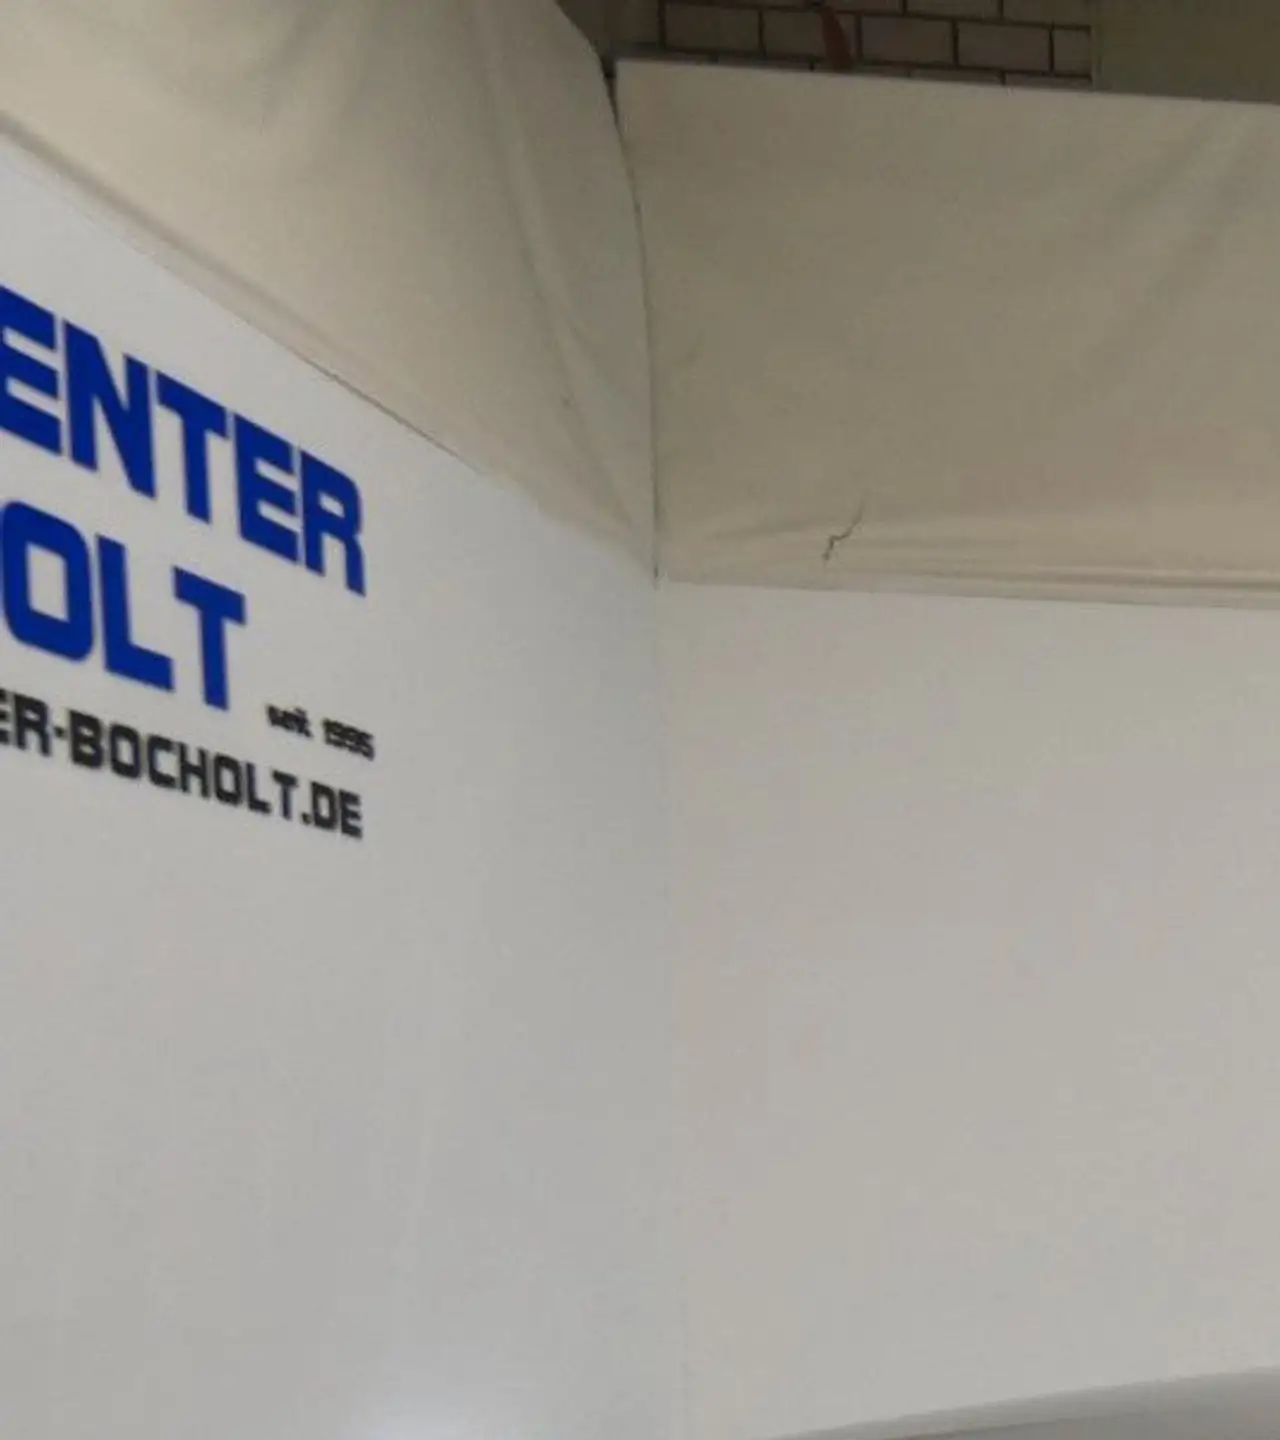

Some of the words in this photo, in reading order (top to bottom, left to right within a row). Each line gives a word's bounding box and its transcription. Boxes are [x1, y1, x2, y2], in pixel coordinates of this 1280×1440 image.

[0, 501, 246, 711] OLT
[265, 704, 313, 738] seit
[320, 717, 375, 761] 1995
